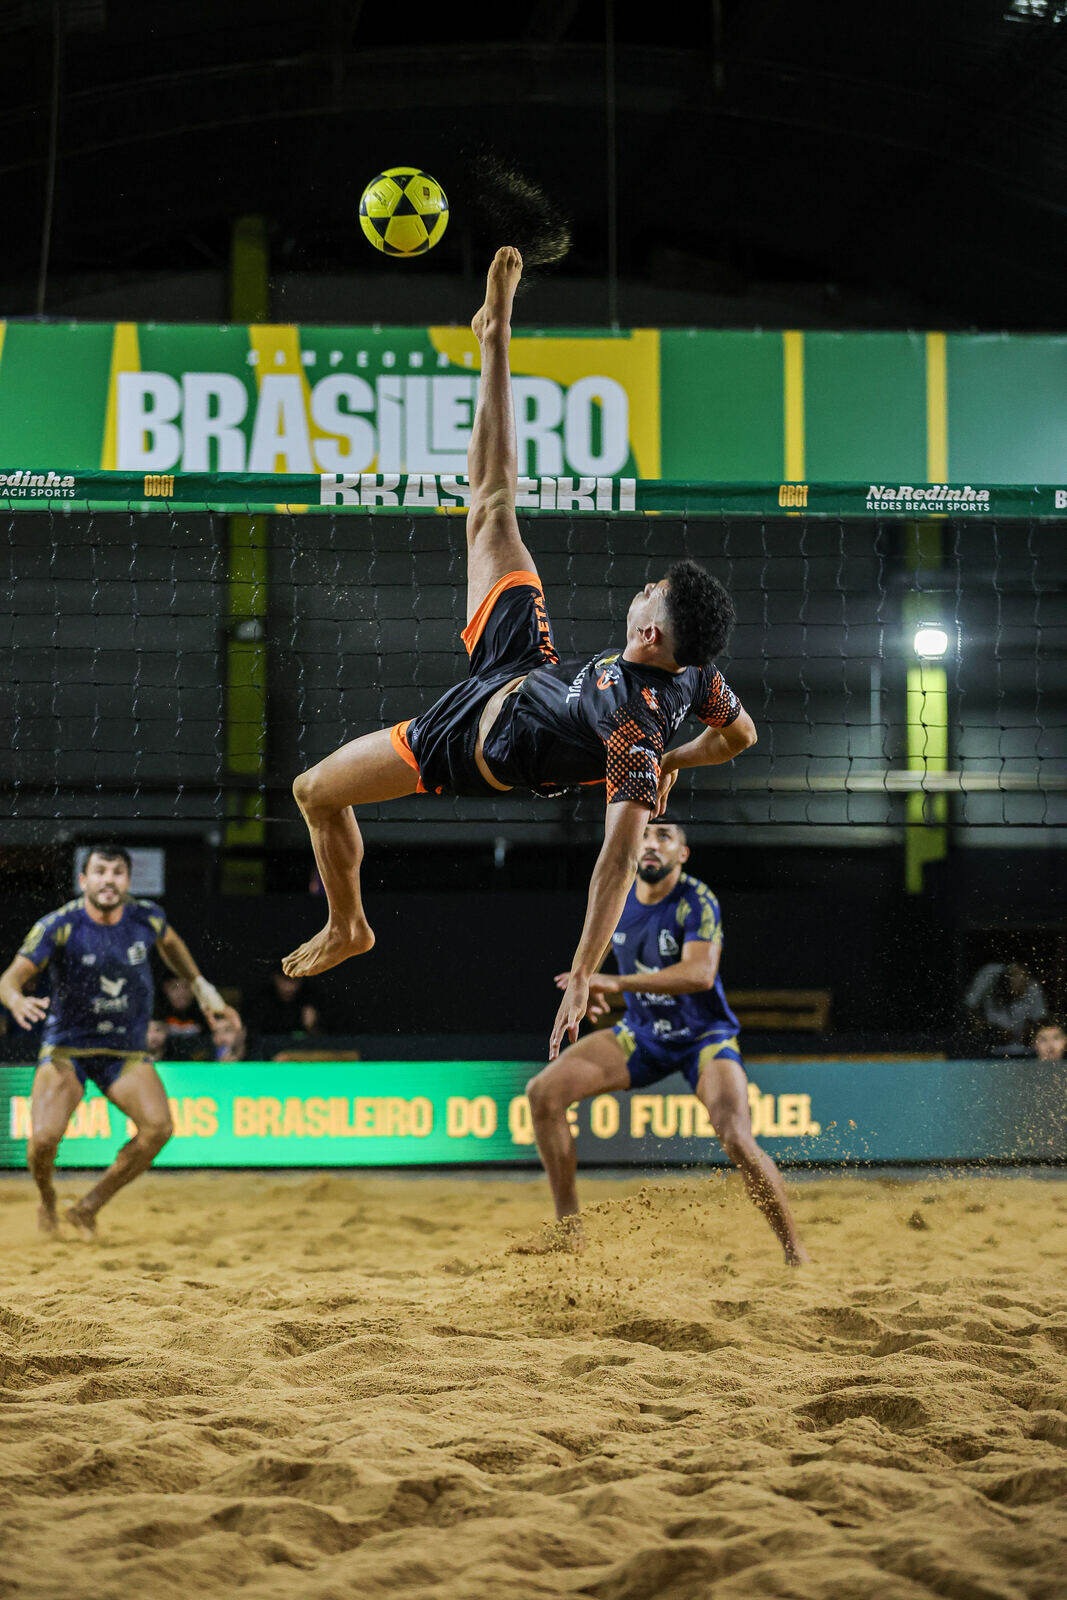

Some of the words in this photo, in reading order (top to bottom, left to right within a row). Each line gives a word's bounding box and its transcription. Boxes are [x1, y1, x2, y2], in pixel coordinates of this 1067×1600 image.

[247, 350, 474, 369] CAMPEONAT
[116, 371, 629, 476] BRASILERO
[0, 488, 26, 497] ACH
[30, 488, 75, 497] SPORTS
[865, 485, 990, 501] NaRedinha
[866, 501, 902, 510] REDES
[905, 502, 943, 511] BEACH
[946, 502, 990, 511] SPORTS
[233, 1096, 433, 1138] BRASILEIRO
[446, 1096, 497, 1138] DO
[590, 1094, 620, 1139] O
